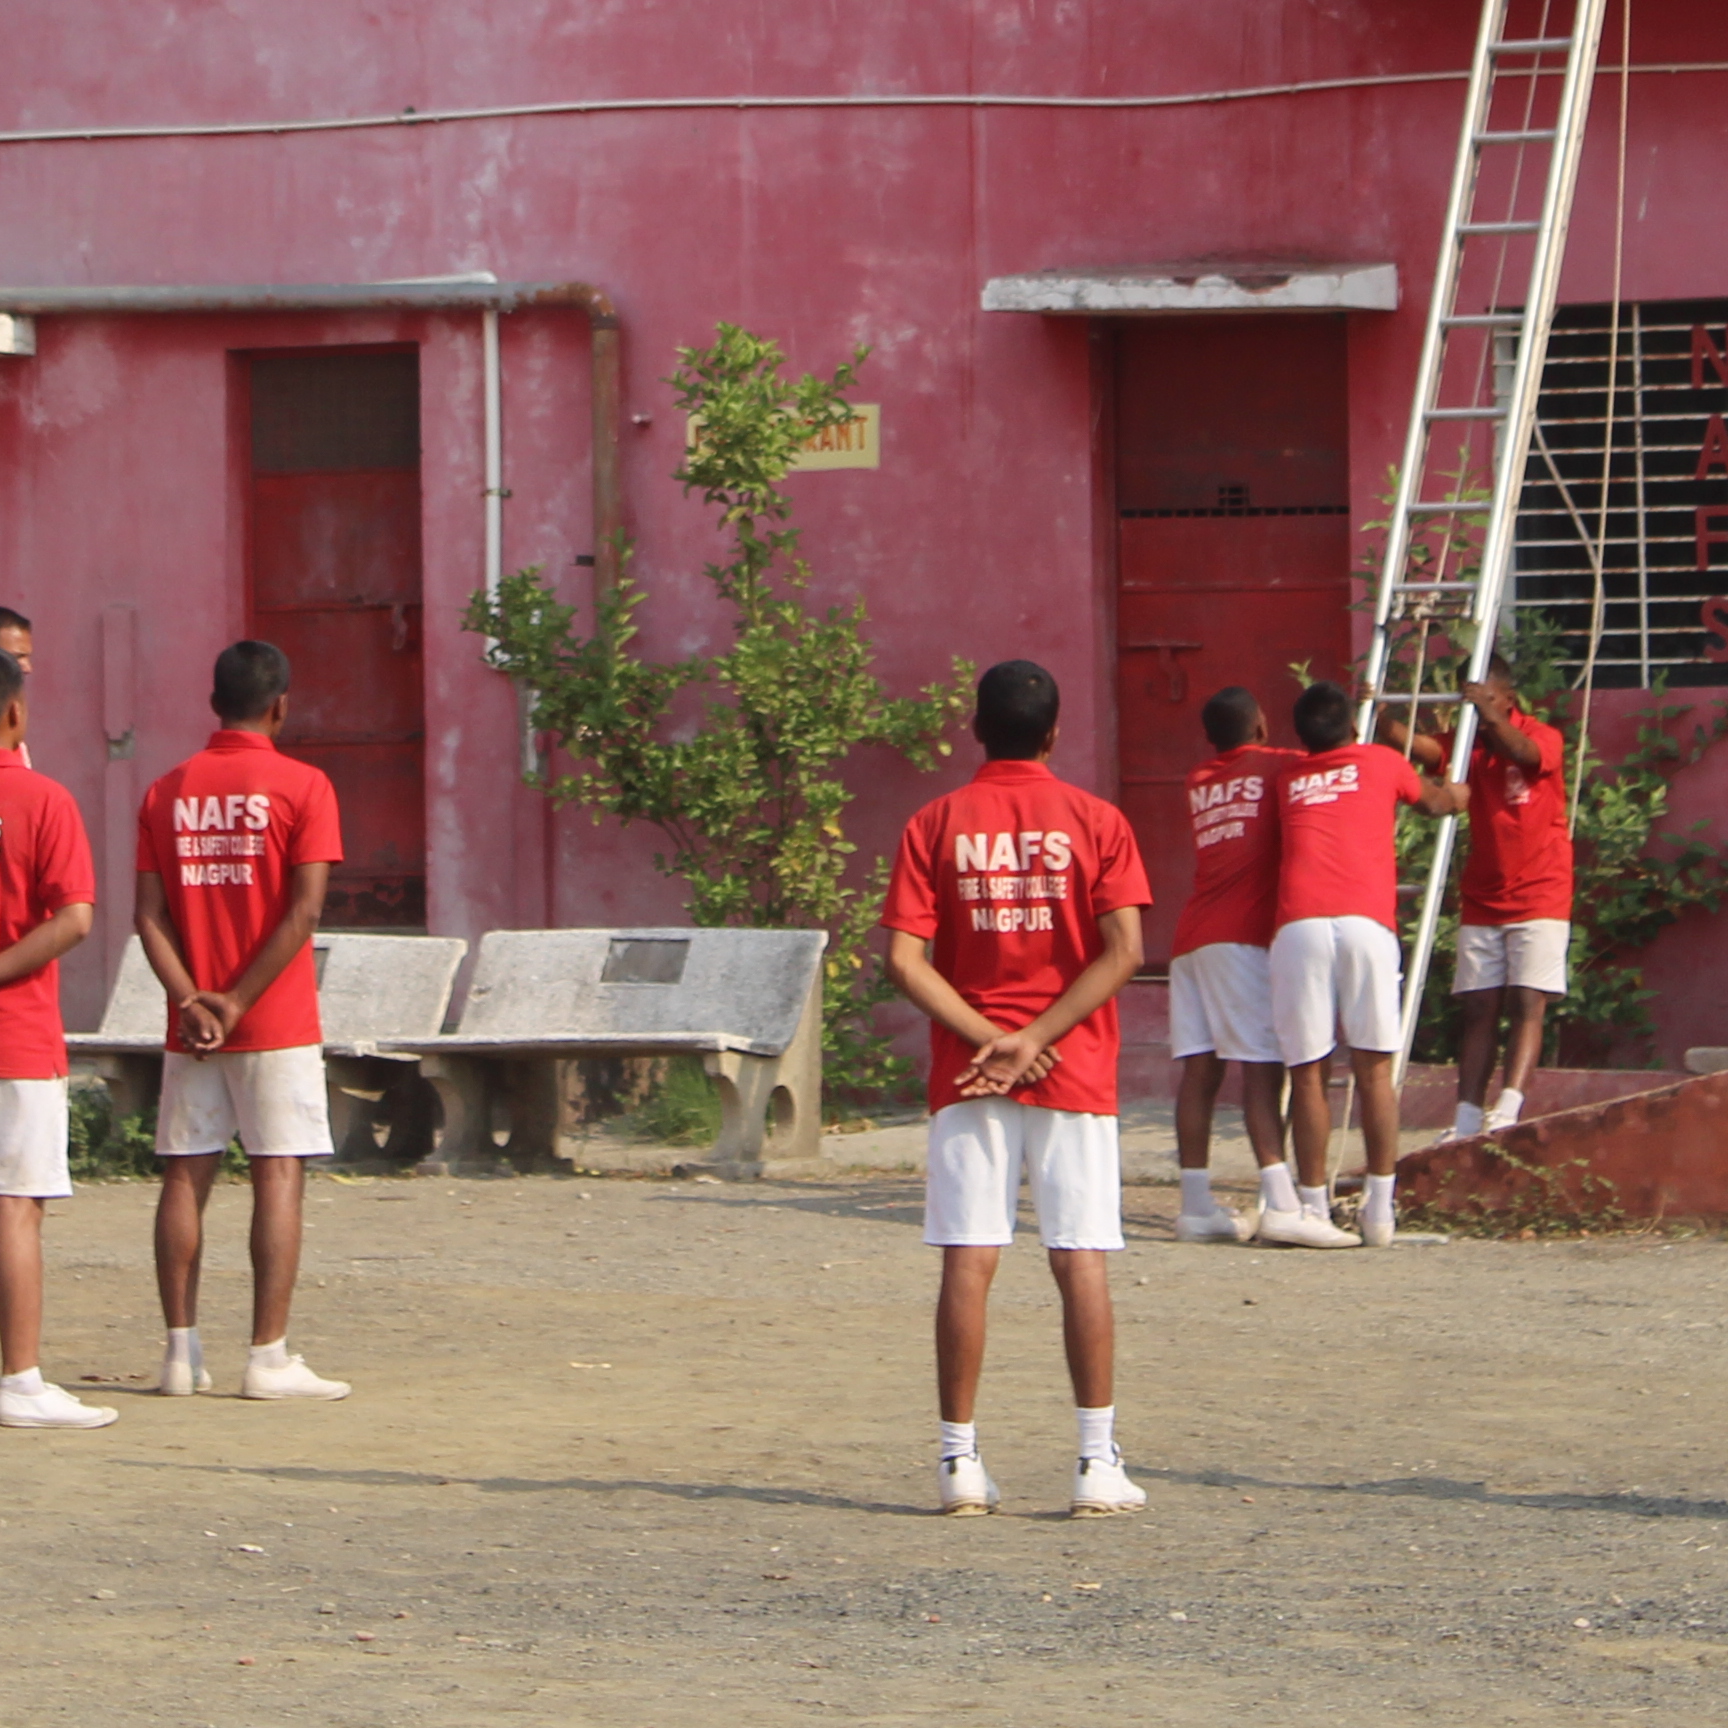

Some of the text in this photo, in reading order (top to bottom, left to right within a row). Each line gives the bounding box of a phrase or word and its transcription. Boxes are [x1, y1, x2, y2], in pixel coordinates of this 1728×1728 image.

[1189, 775, 1263, 815] NAFS
[1289, 763, 1359, 796] NAFS
[174, 794, 270, 832] NAFS
[955, 830, 1072, 872] NAFS
[181, 863, 253, 886] NAGPUR
[971, 906, 1053, 933] NAGPUR
